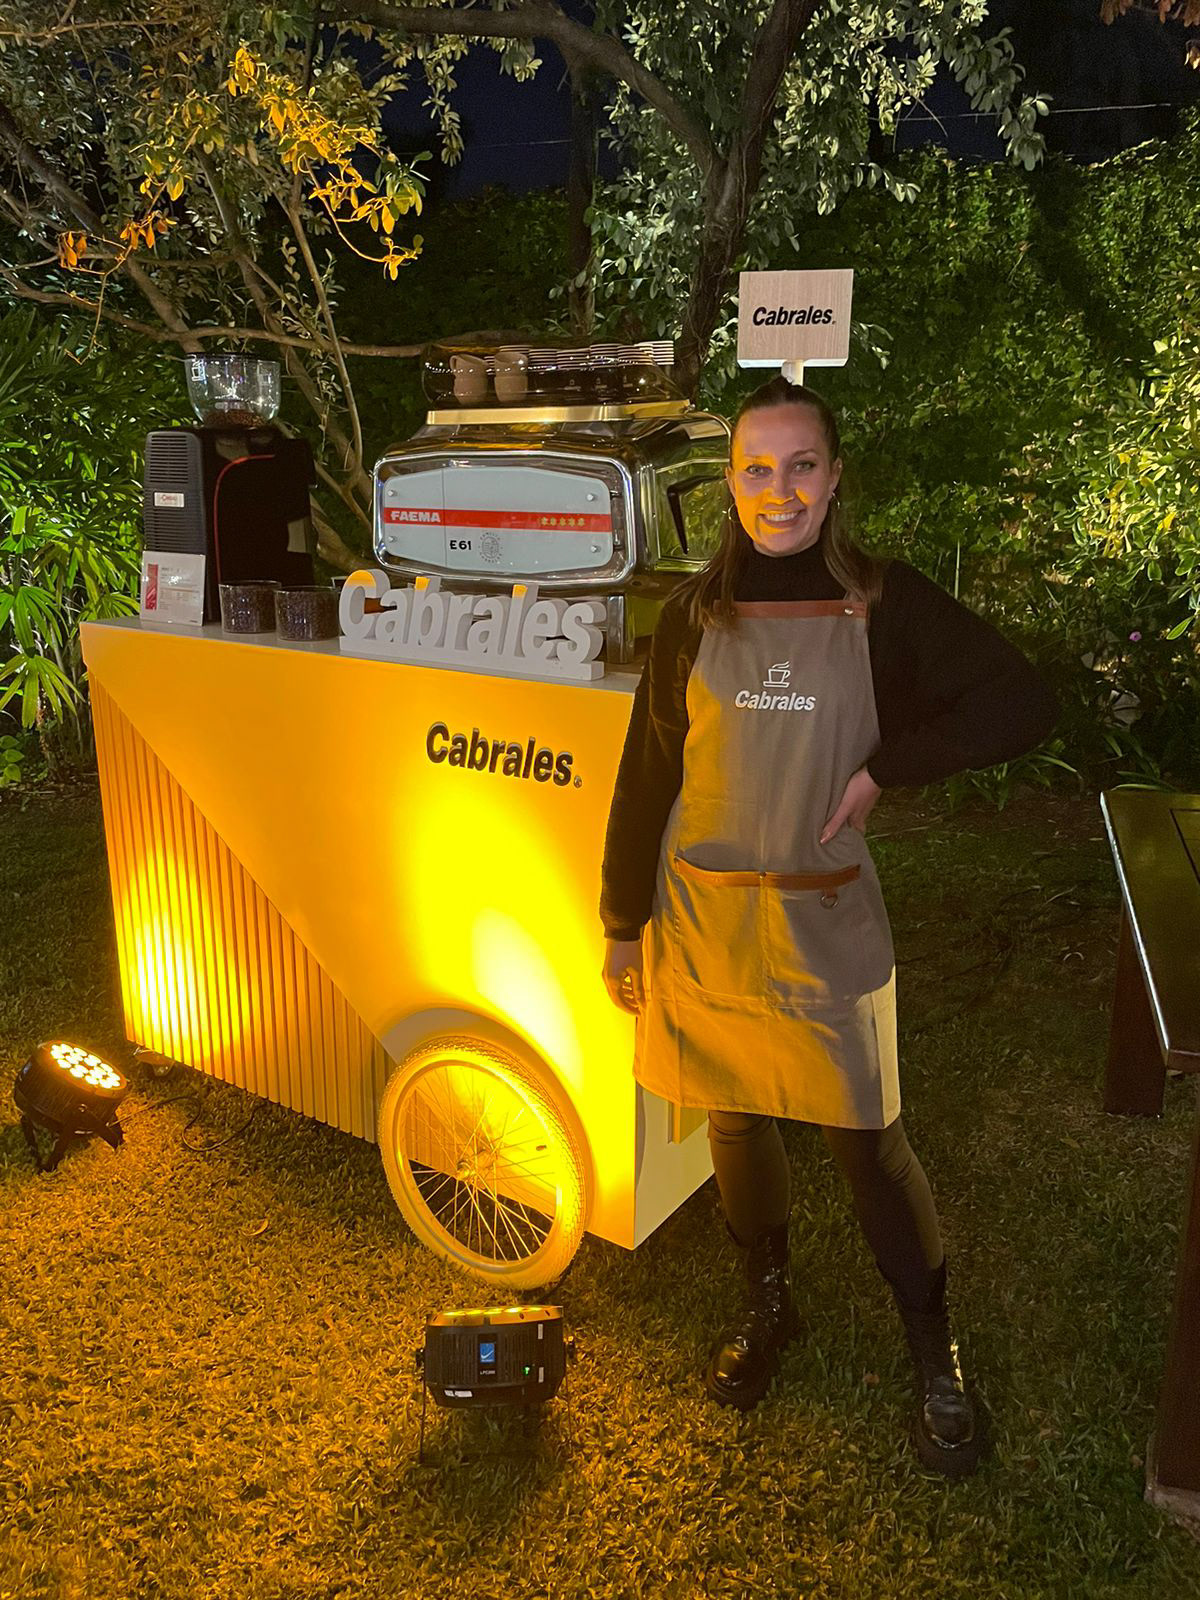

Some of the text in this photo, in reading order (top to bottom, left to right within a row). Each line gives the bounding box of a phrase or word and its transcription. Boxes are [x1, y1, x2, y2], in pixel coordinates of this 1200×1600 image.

[390, 510, 441, 523] FAEMA
[449, 540, 472, 551] E61
[338, 568, 606, 665] Cabrales
[735, 690, 817, 711] Cabrales
